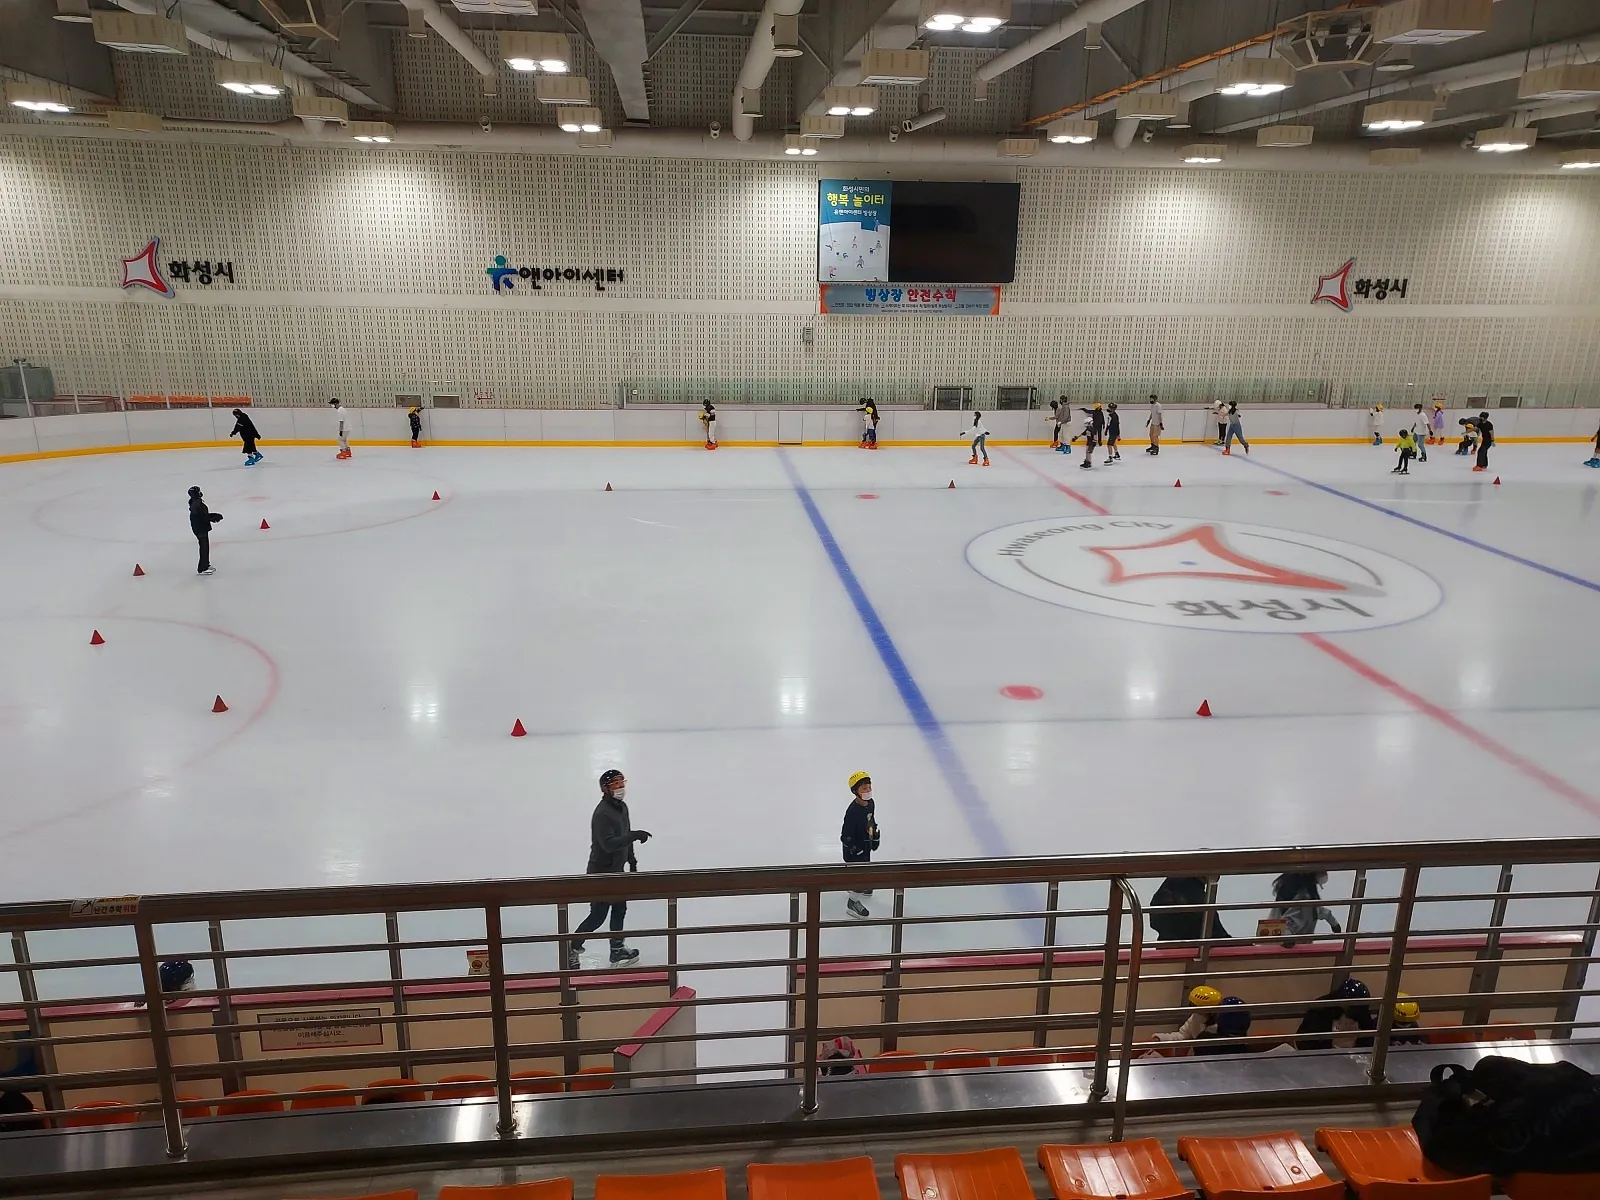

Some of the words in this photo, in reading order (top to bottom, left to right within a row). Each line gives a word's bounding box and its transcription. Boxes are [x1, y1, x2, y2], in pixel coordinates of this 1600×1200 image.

[827, 193, 849, 207] 행복
[853, 194, 885, 208] 놀이터
[842, 185, 870, 194] 화성시민의
[168, 260, 235, 285] 화성시
[865, 288, 903, 303] 빙상장
[906, 288, 957, 303] 안전수칙
[1353, 278, 1409, 300] 화성시
[997, 522, 1104, 557] Hwaseong
[1108, 520, 1174, 530] City
[1166, 598, 1374, 621] 화성시
